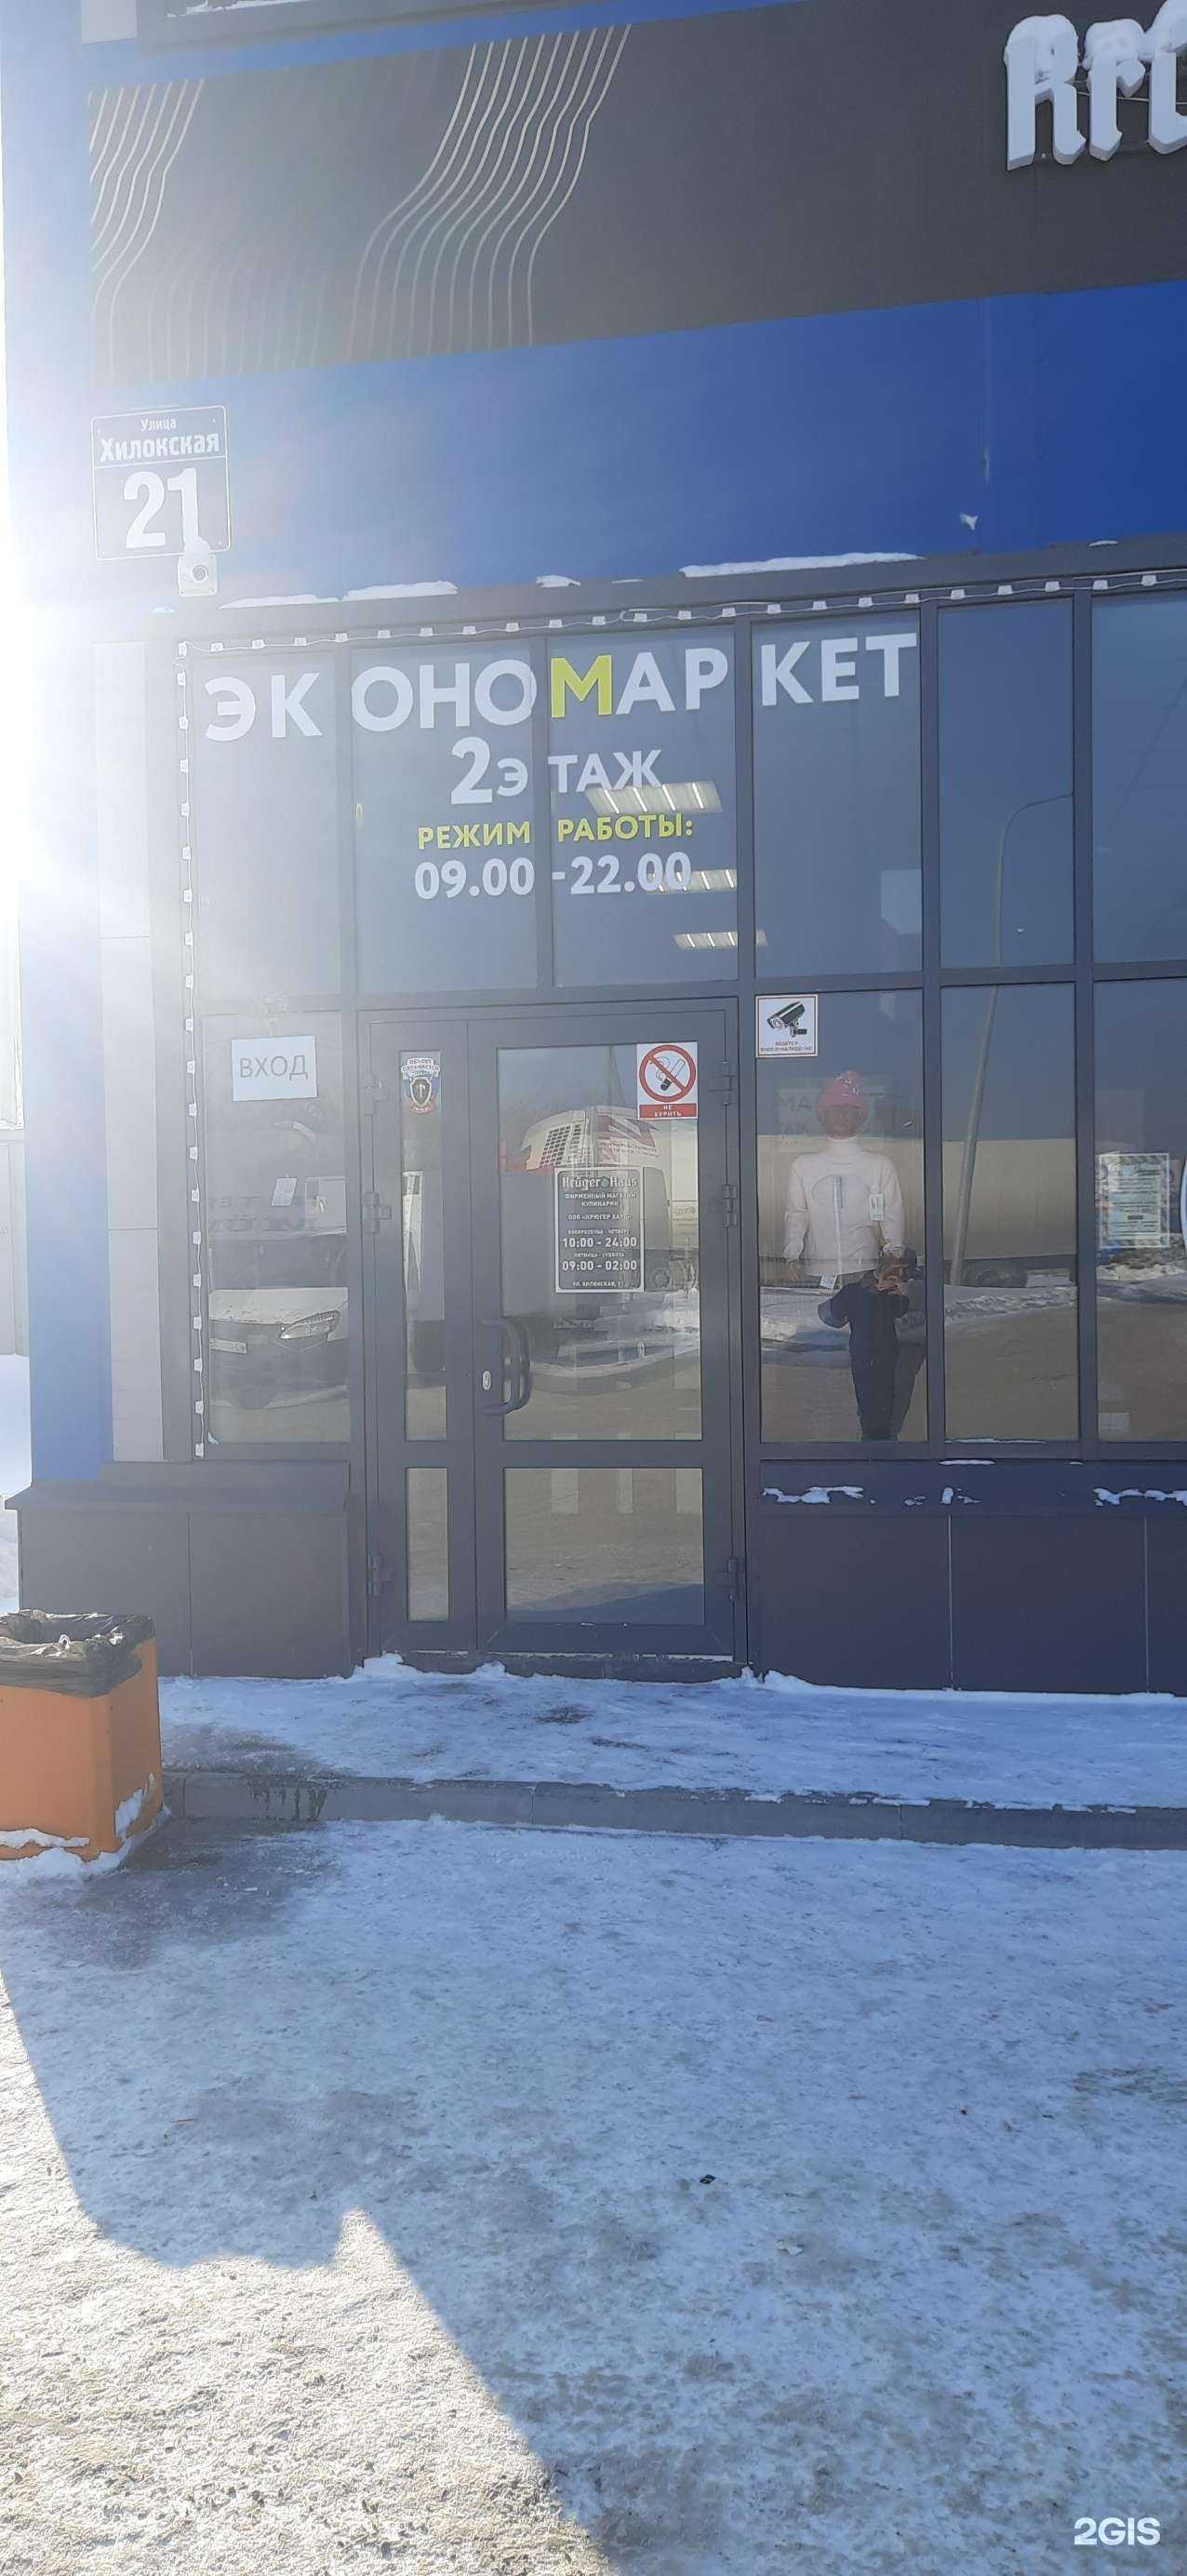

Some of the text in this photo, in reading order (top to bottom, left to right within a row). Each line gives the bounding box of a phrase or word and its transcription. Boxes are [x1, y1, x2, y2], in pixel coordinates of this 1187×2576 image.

[140, 418, 177, 432] Улица
[100, 433, 220, 463] Хилокская
[124, 467, 199, 549] 21
[418, 812, 693, 849] РЕЖИМ РАБОТЫ:
[414, 857, 535, 900] 09.00
[239, 1053, 308, 1080] ВХОД
[562, 1237, 594, 1248] 10:00
[605, 1236, 637, 1248] 24:00
[562, 1260, 594, 1271] 09:00
[605, 1259, 637, 1271] 02:00
